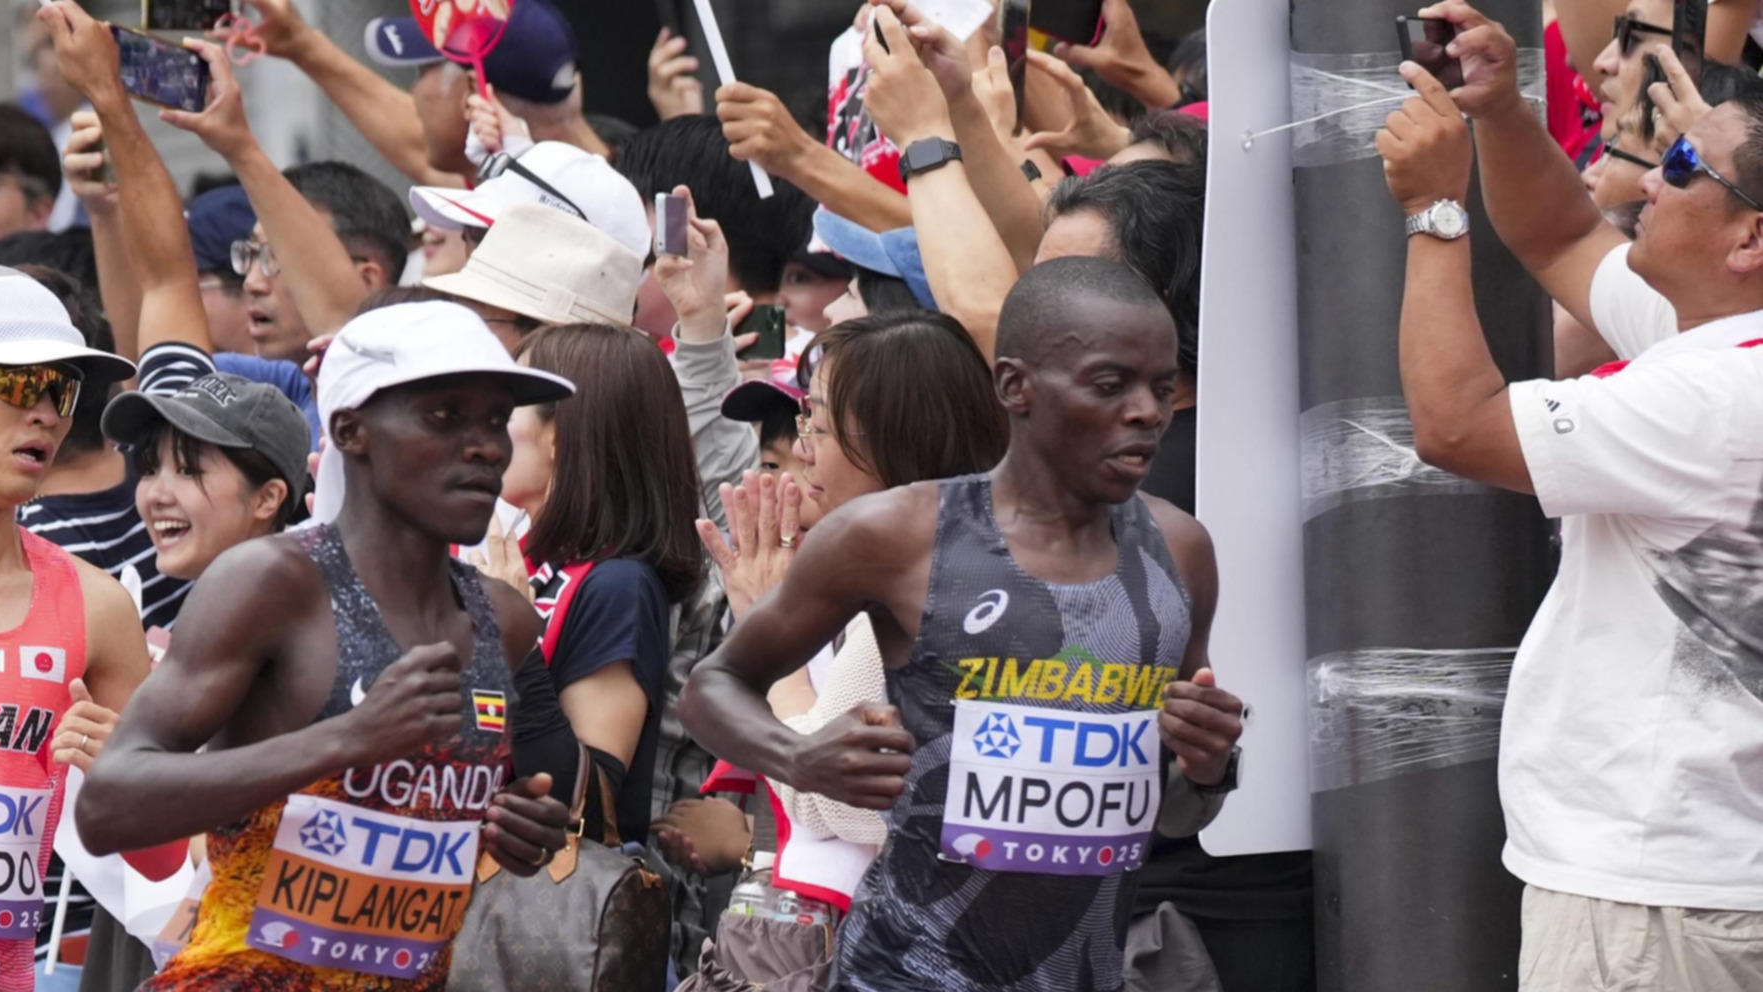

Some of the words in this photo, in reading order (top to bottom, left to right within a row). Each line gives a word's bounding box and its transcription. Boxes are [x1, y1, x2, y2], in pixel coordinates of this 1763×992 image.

[955, 657, 1176, 709] ZIMBABWE
[1023, 716, 1150, 768] TDK
[343, 759, 504, 811] UGANDA
[963, 771, 1150, 828] MPOFU
[352, 816, 471, 876] TDK
[271, 860, 463, 935] KIPLANGAT
